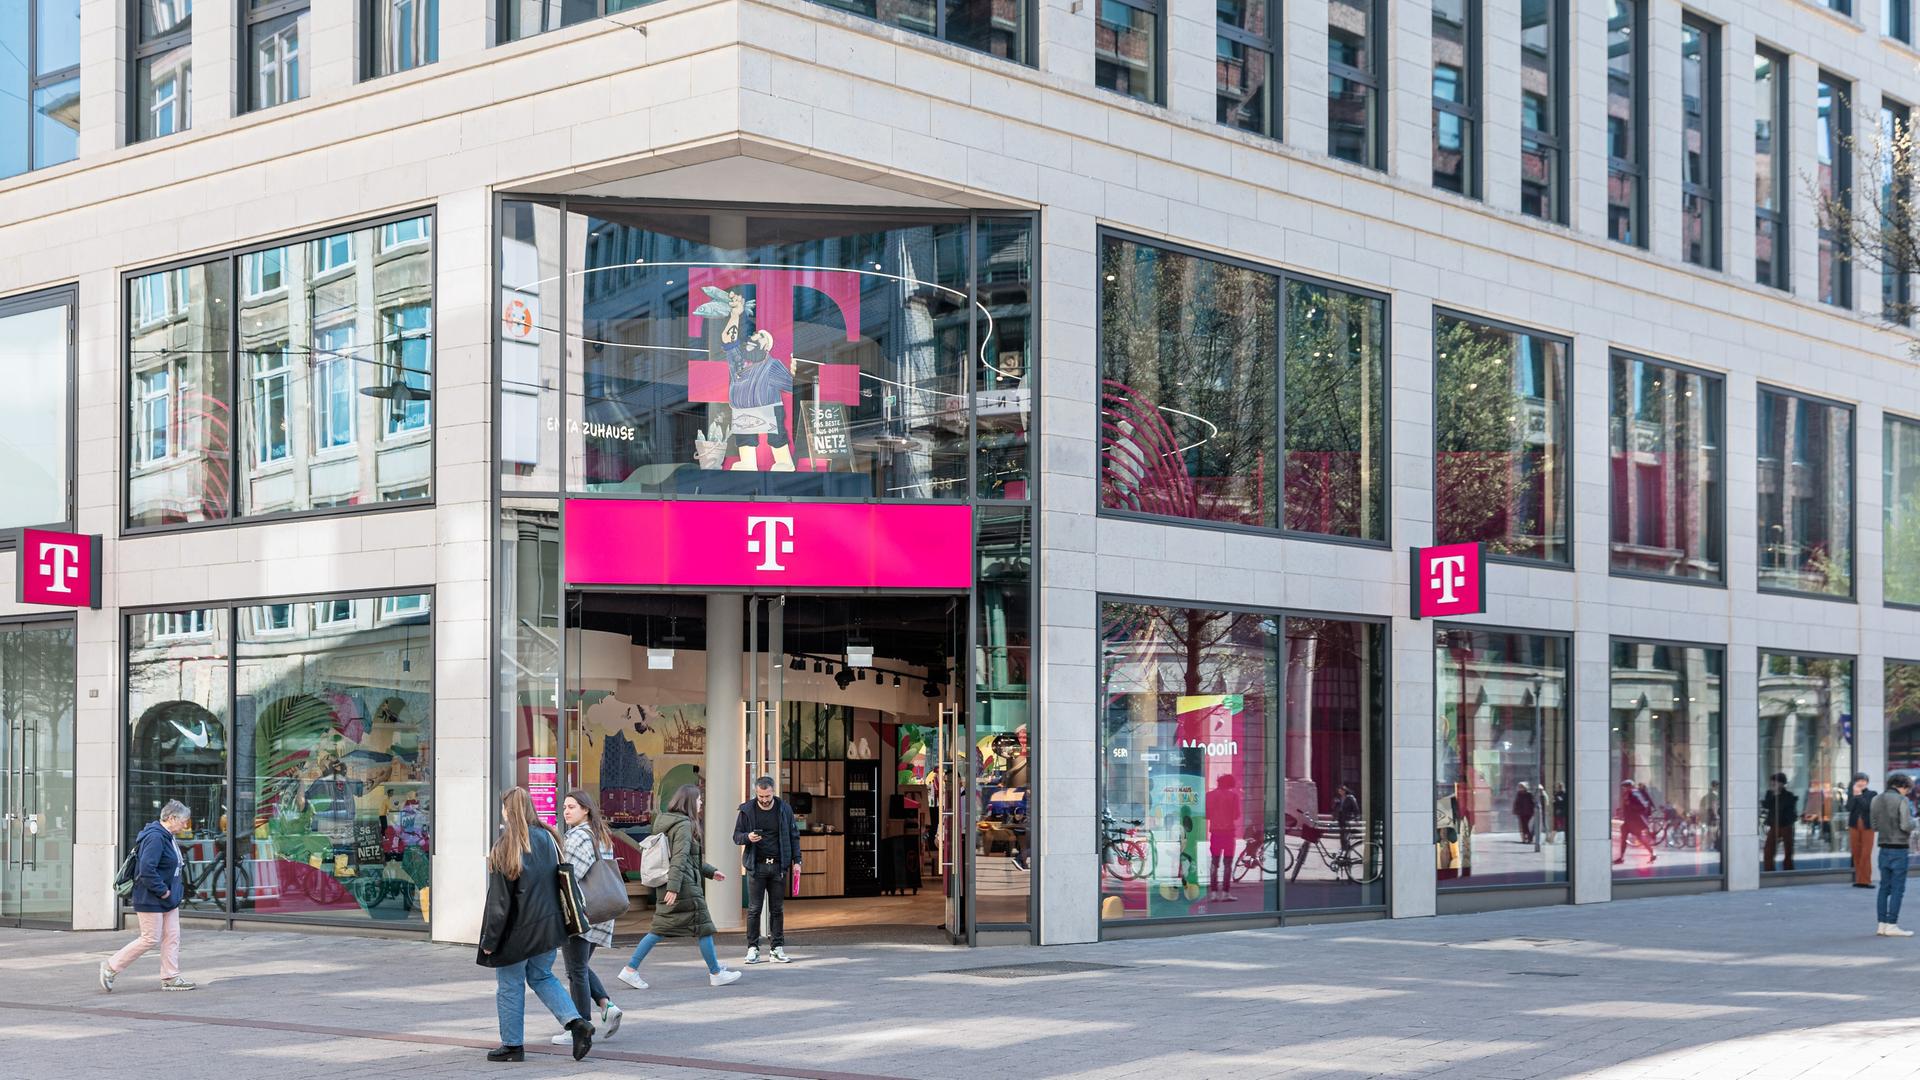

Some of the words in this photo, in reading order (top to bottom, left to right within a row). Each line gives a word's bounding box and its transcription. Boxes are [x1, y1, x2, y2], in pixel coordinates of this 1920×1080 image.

[815, 409, 833, 419] 5G
[582, 422, 635, 441] ZUHAUSE
[814, 434, 847, 450] NETZ
[748, 516, 794, 571] T
[39, 542, 79, 593] T
[1430, 555, 1465, 604] T
[358, 845, 381, 858] NETZ
